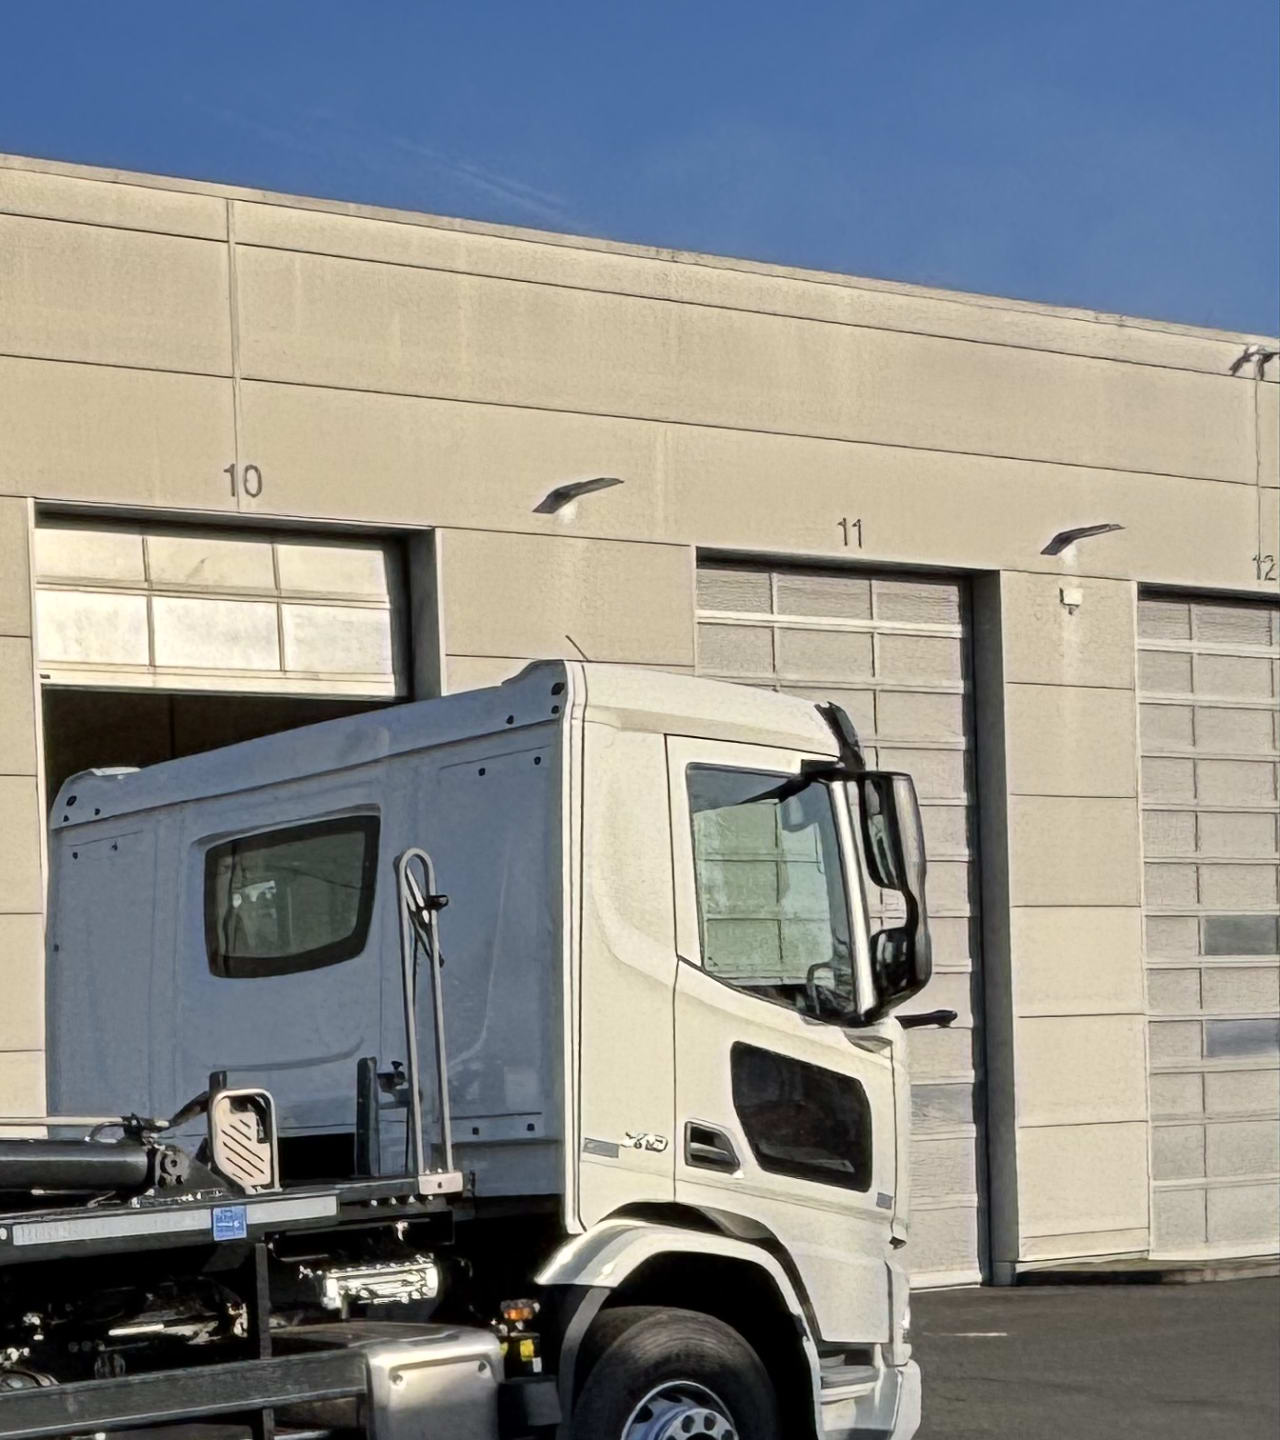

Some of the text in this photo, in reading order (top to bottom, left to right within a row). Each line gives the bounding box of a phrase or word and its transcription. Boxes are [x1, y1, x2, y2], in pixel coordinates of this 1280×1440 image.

[223, 463, 262, 498] 10
[837, 517, 862, 549] 11
[1252, 554, 1277, 581] 12
